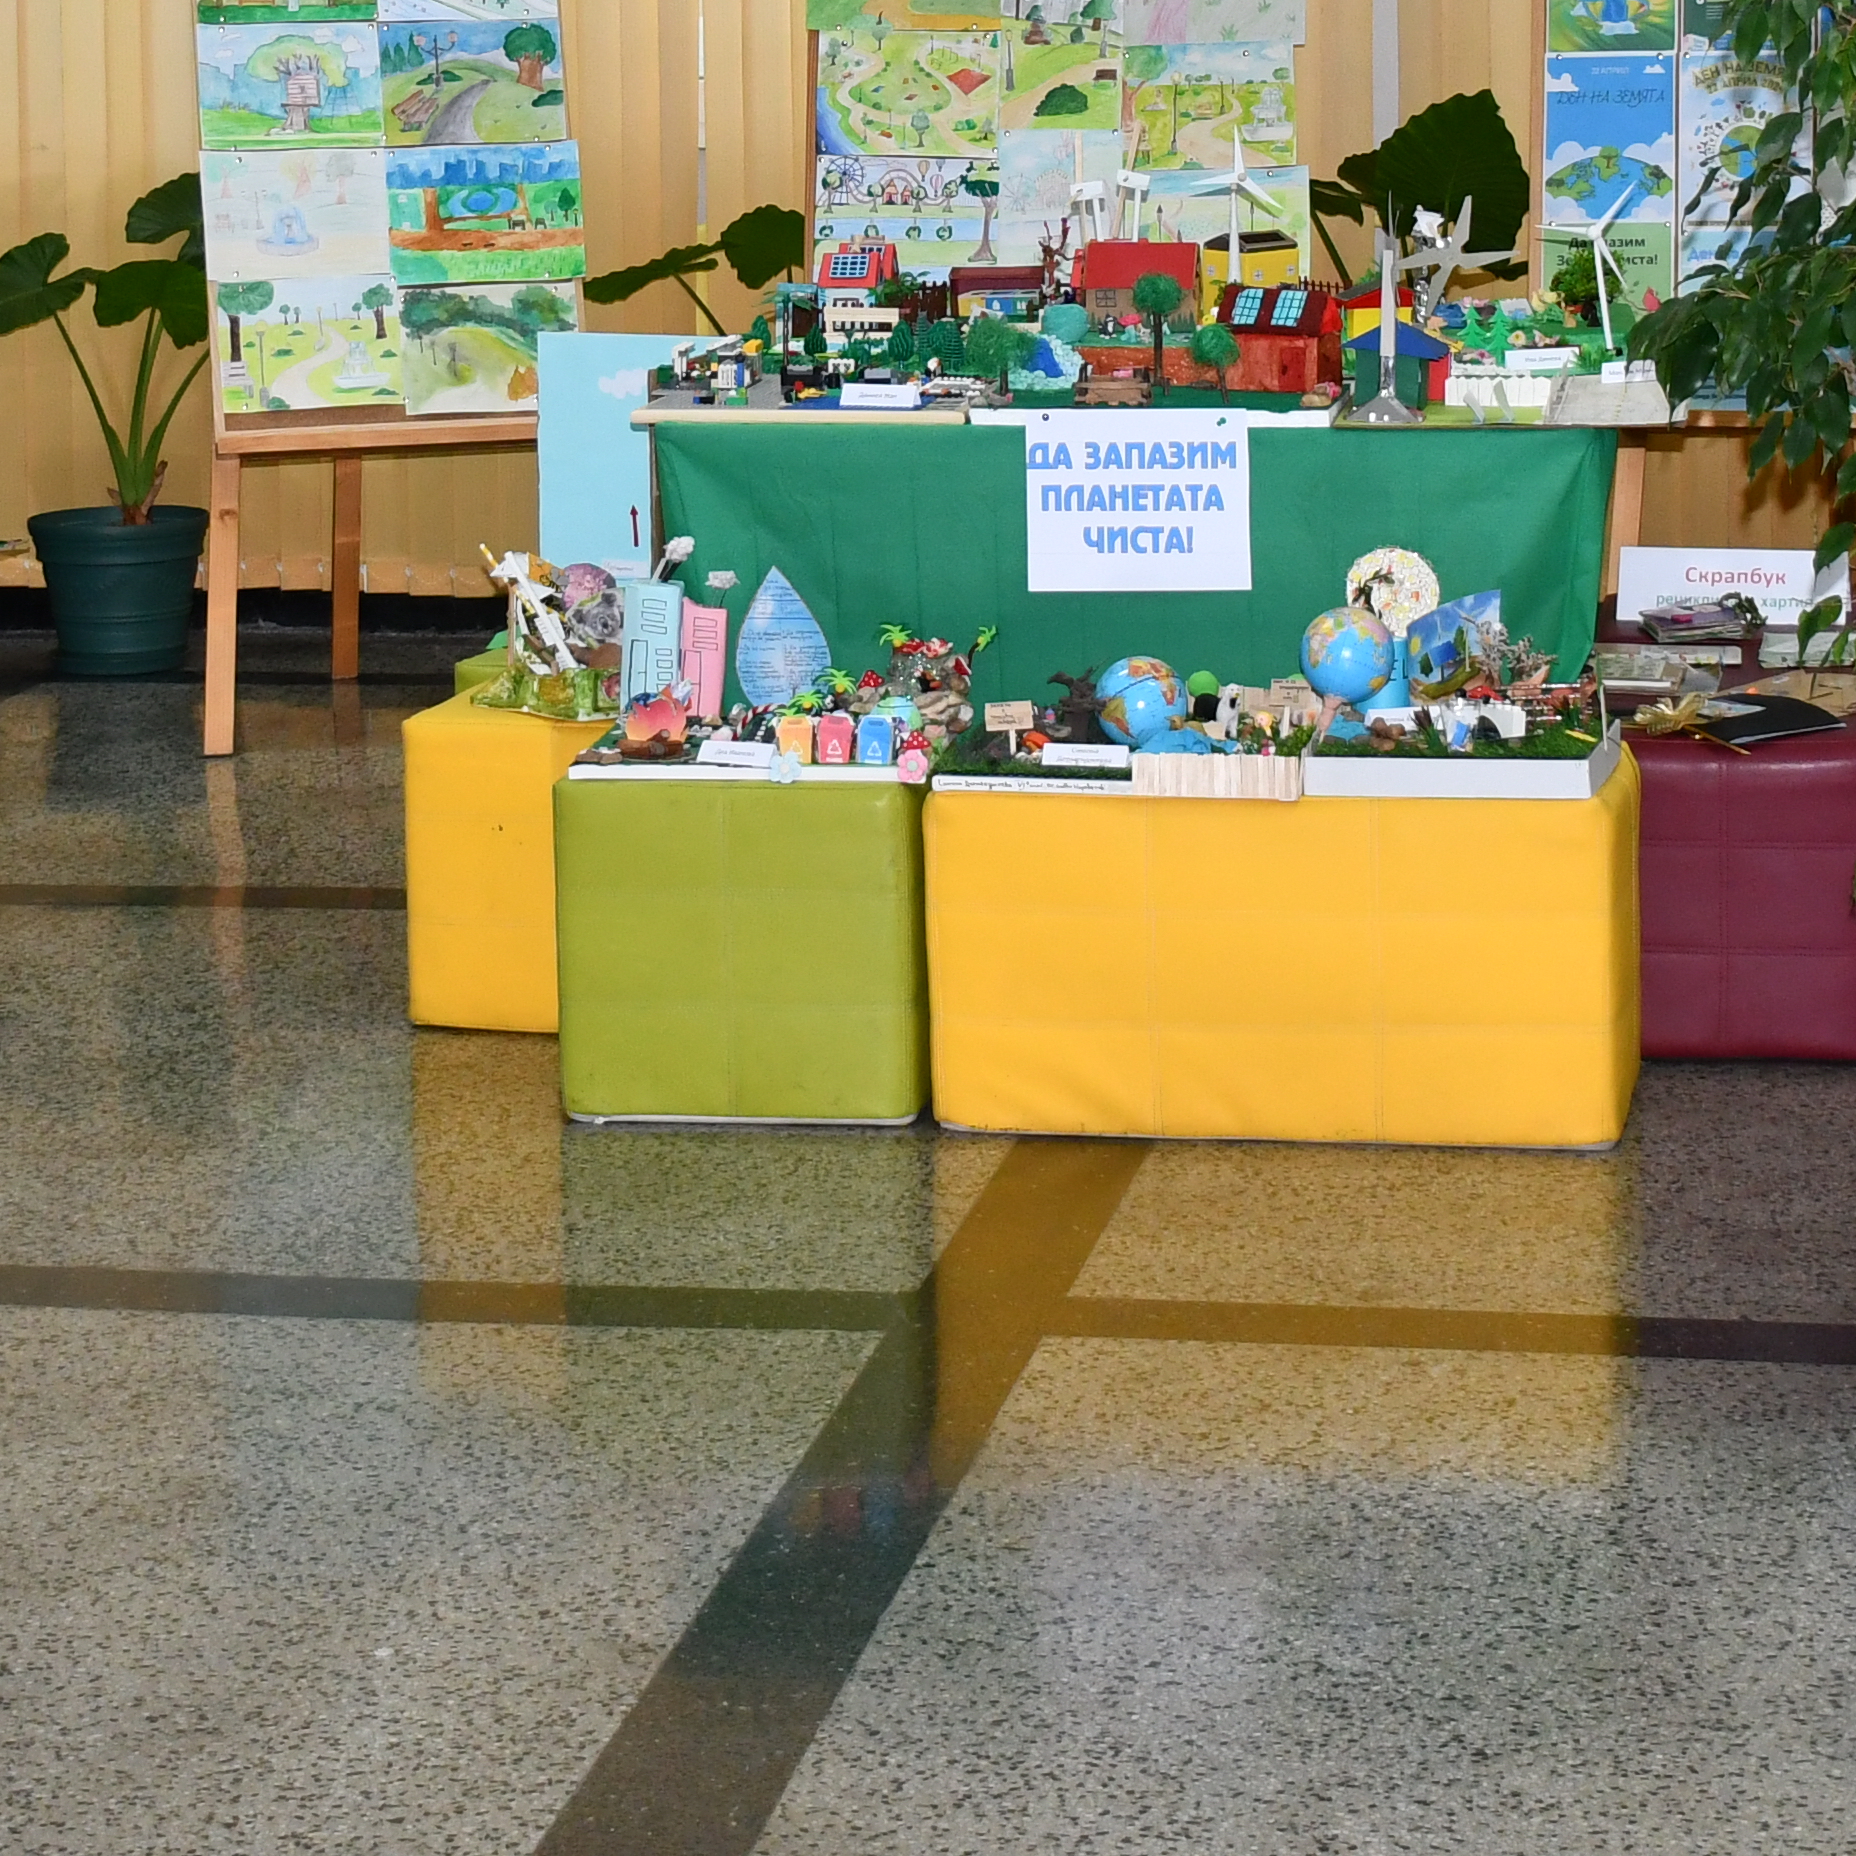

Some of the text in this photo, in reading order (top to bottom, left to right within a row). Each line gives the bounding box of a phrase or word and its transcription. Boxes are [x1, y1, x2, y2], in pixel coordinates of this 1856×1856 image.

[1725, 61, 1743, 72] НА
[1591, 90, 1609, 104] НА
[1622, 254, 1658, 265] иста!
[1026, 441, 1237, 470] ДА ЗАПАЗИМ
[1040, 484, 1225, 512] ПЛАНЕТАТА
[1083, 526, 1194, 554] ЧИСТА!
[1685, 566, 1787, 588] Скрапбук
